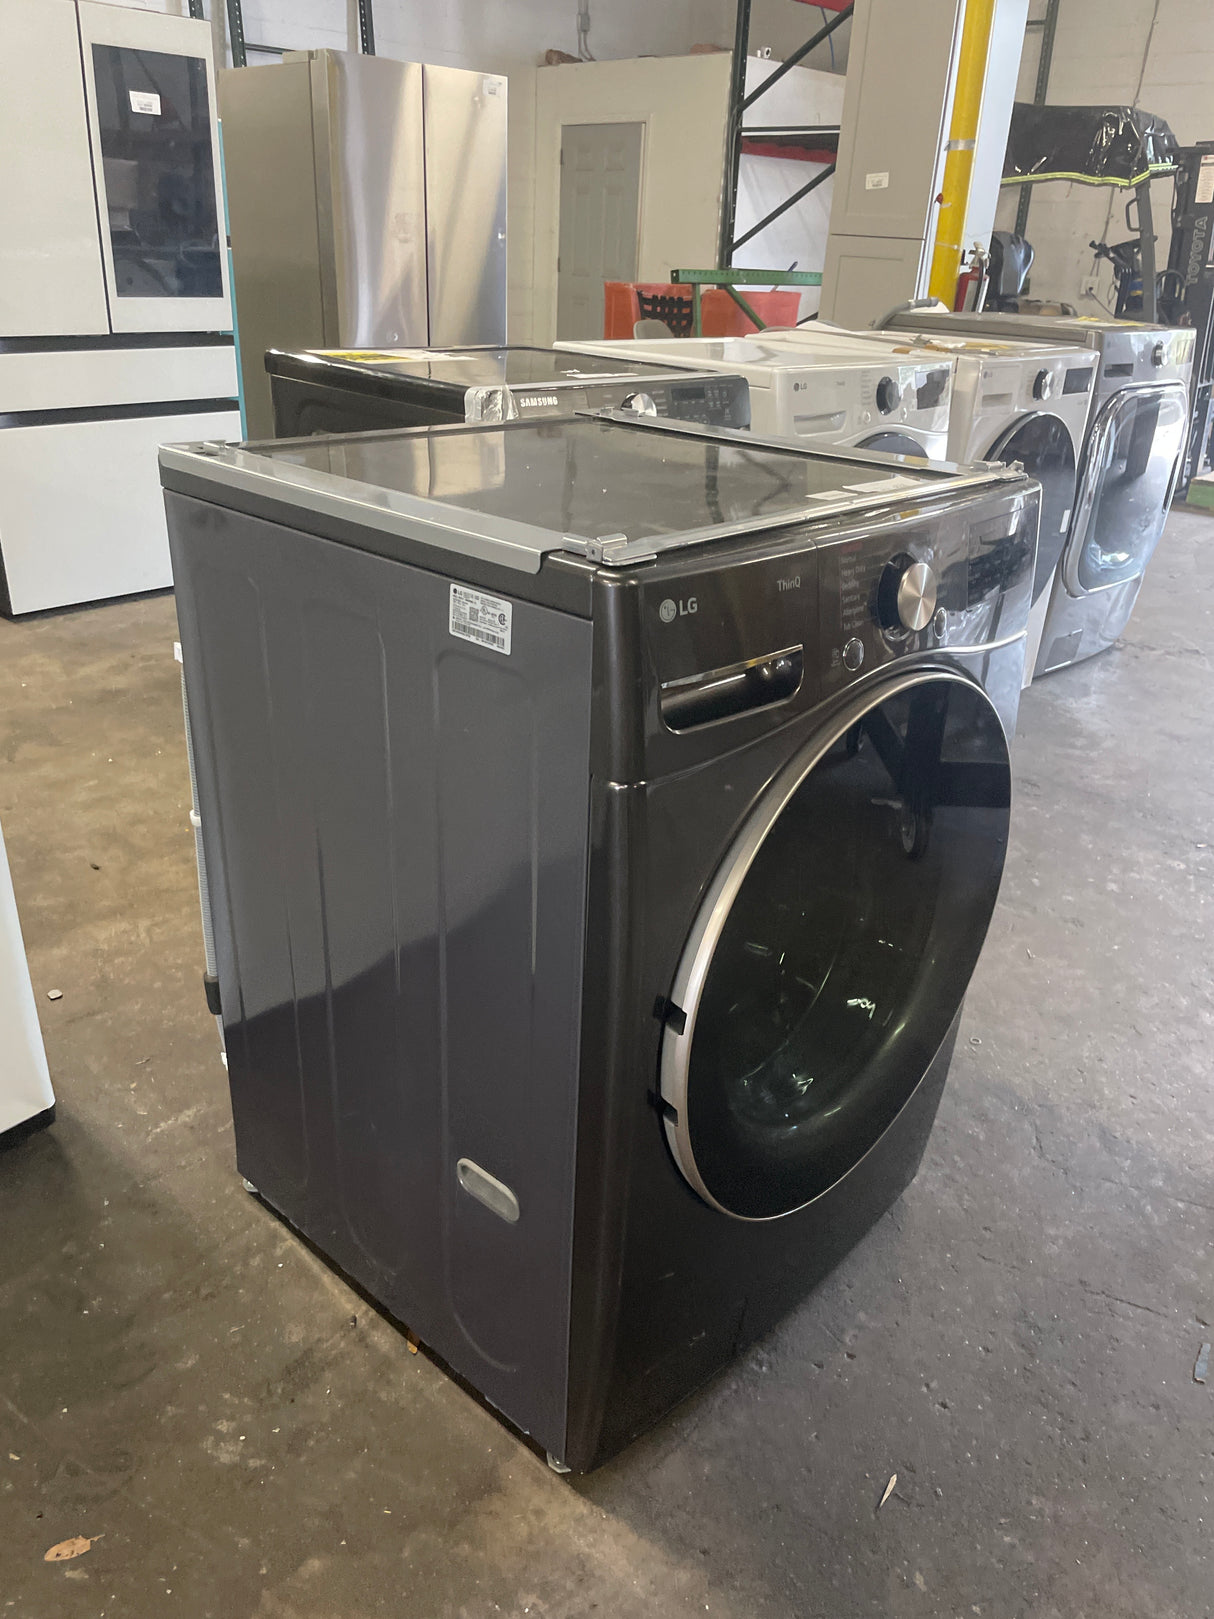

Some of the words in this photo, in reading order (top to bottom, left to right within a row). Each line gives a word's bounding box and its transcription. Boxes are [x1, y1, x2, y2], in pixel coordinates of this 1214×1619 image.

[1186, 216, 1207, 285] TOYOTA
[520, 396, 559, 408] SAMSUNG
[776, 576, 801, 592] ThinQ
[679, 597, 698, 616] LG
